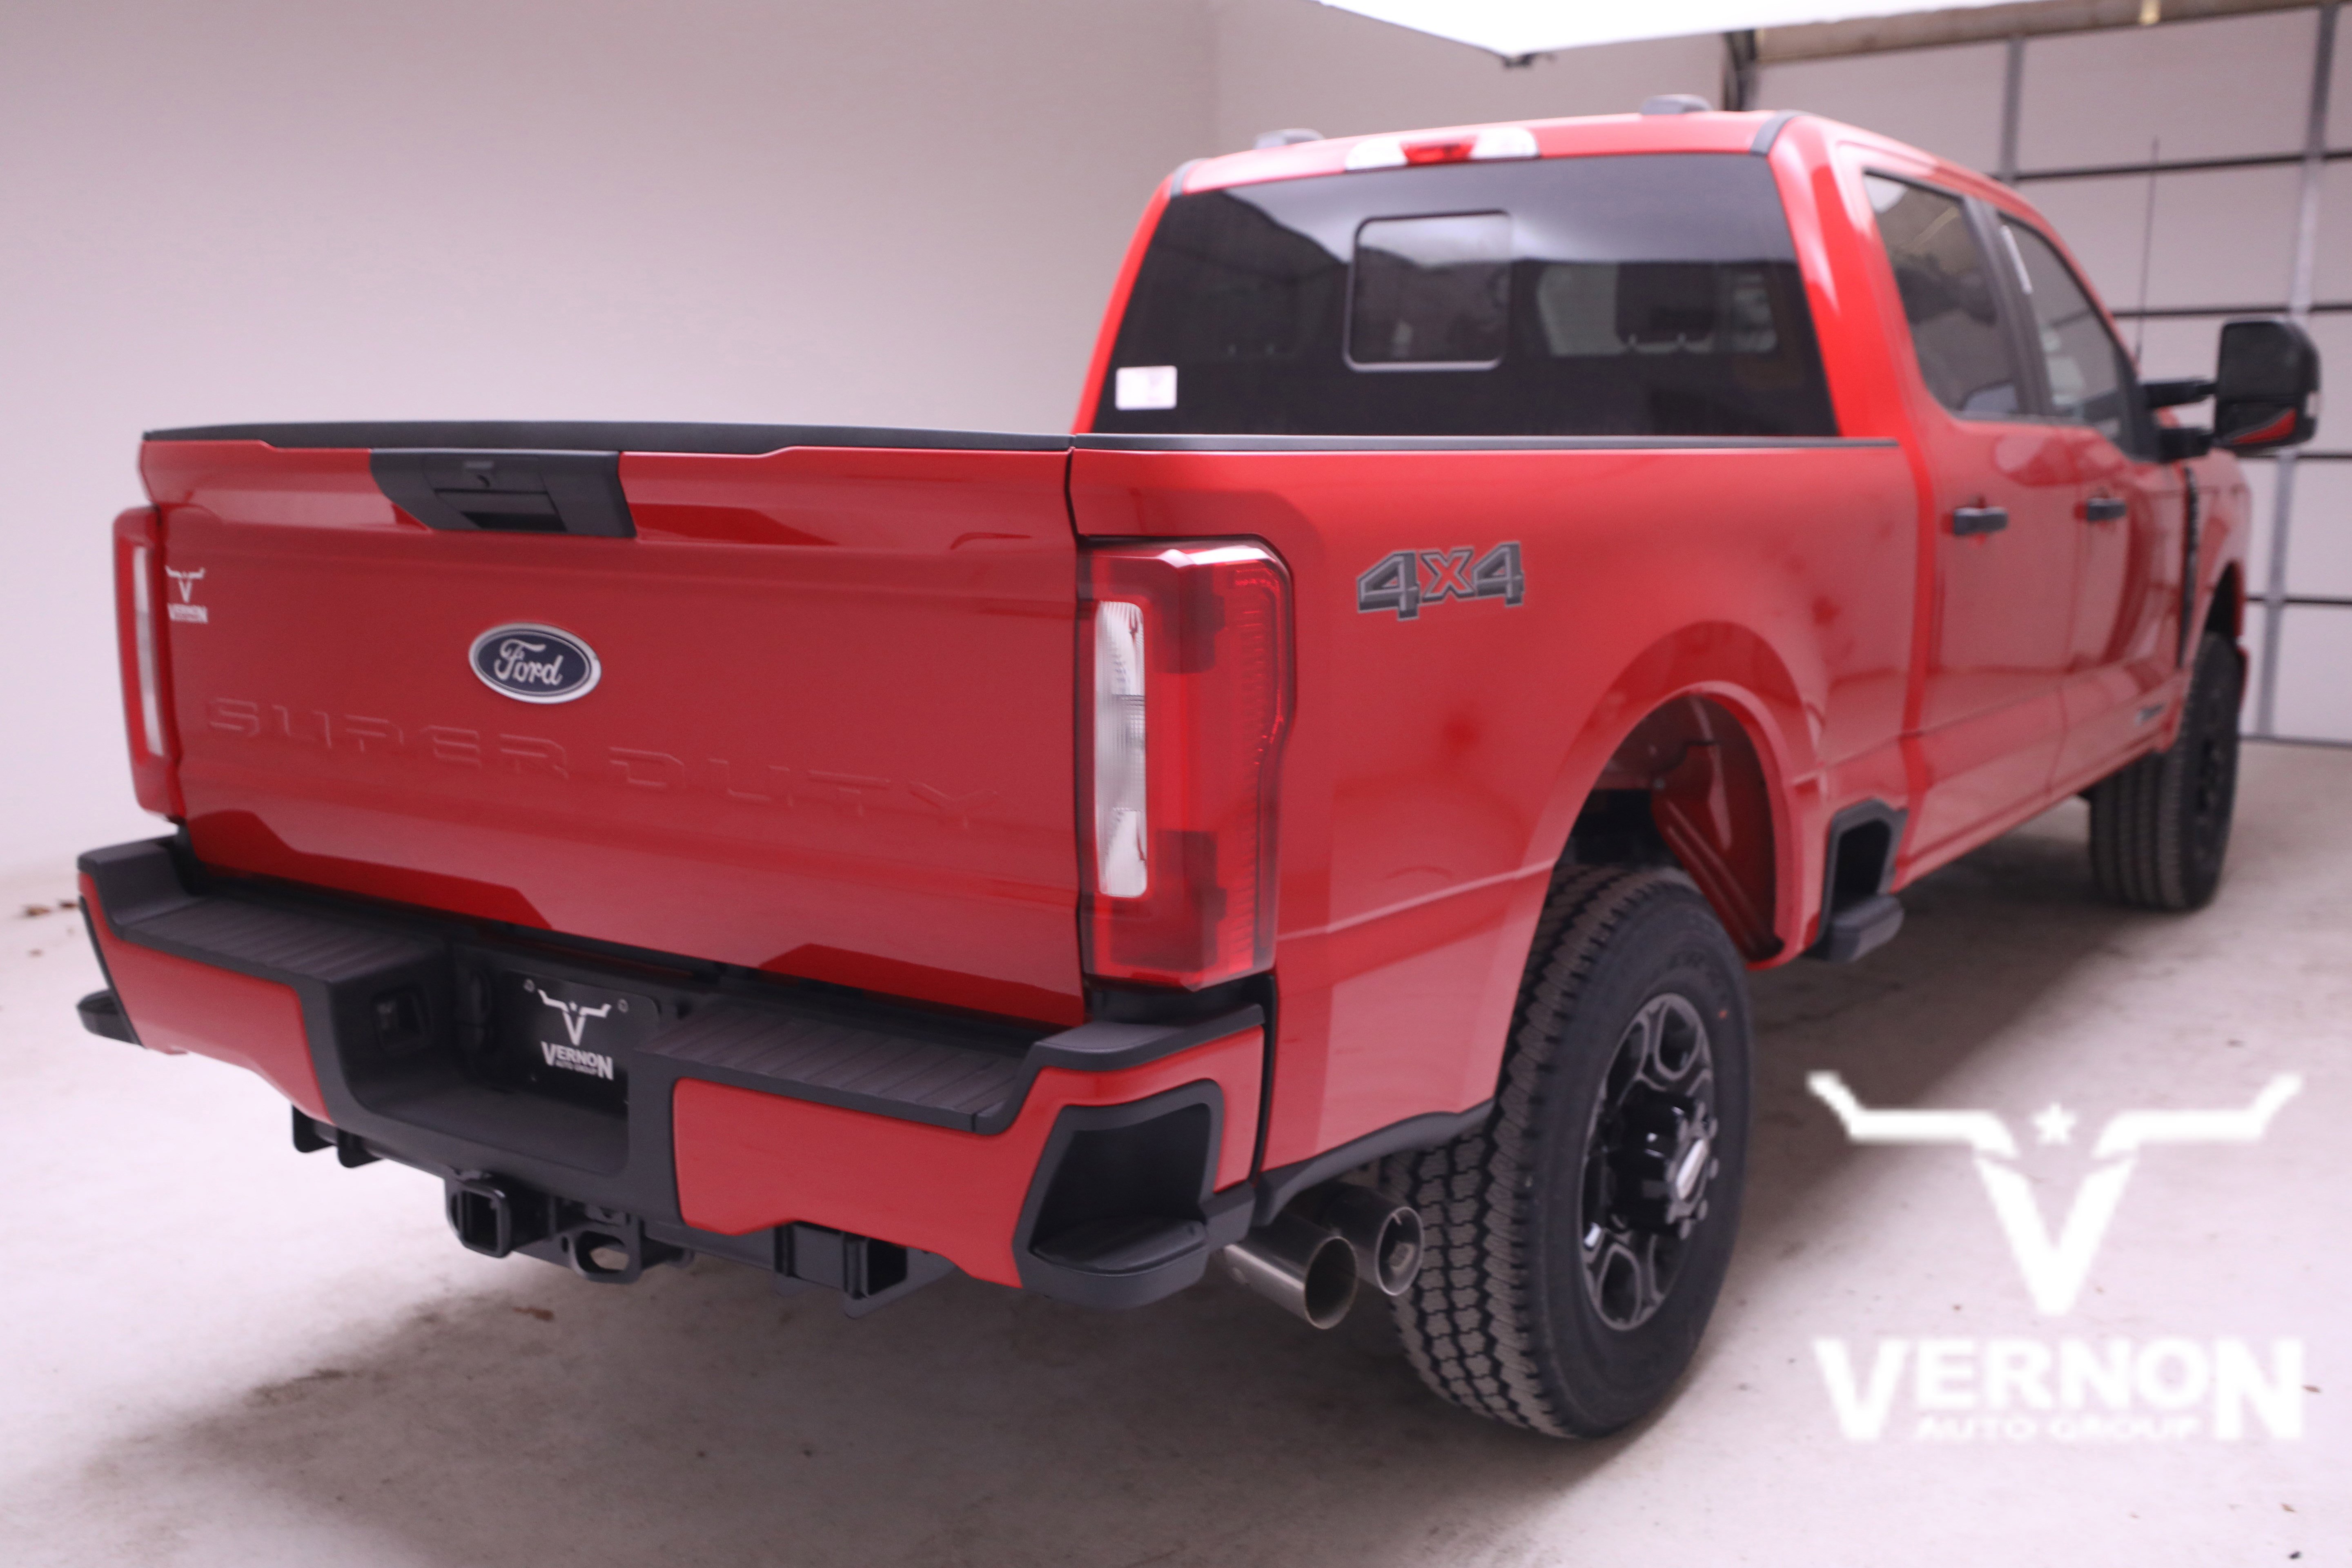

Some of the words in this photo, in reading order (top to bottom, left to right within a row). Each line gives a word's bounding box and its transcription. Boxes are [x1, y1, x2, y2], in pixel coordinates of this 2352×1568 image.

[494, 639, 564, 686] Ford
[208, 697, 570, 781] SUPER
[607, 746, 999, 830] DUTY
[540, 1041, 614, 1081] VERNON
